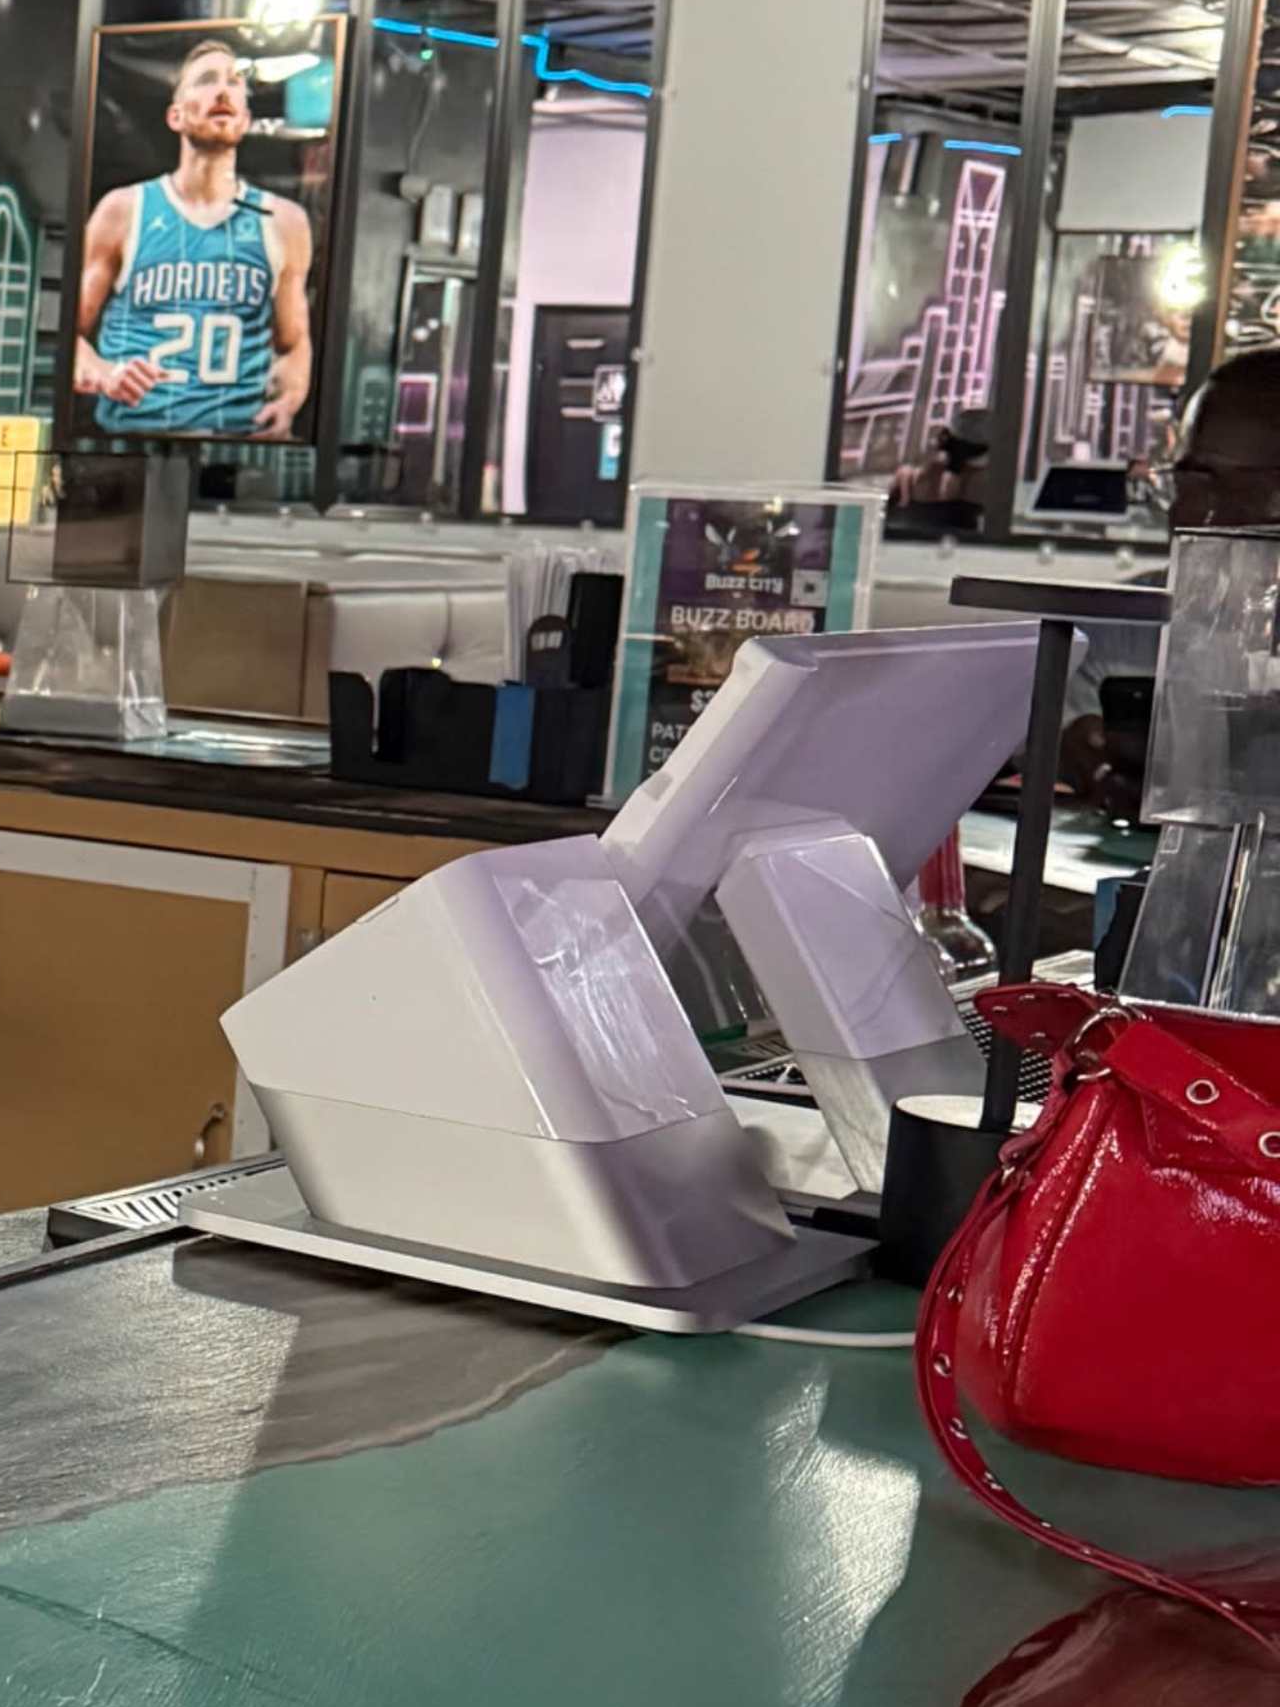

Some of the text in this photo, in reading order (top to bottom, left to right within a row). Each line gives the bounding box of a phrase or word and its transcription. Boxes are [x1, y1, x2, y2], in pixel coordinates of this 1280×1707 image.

[134, 261, 267, 306] HORNETS
[149, 312, 242, 384] 20
[671, 606, 815, 633] BUZZ BOARD
[651, 723, 687, 740] PAT
